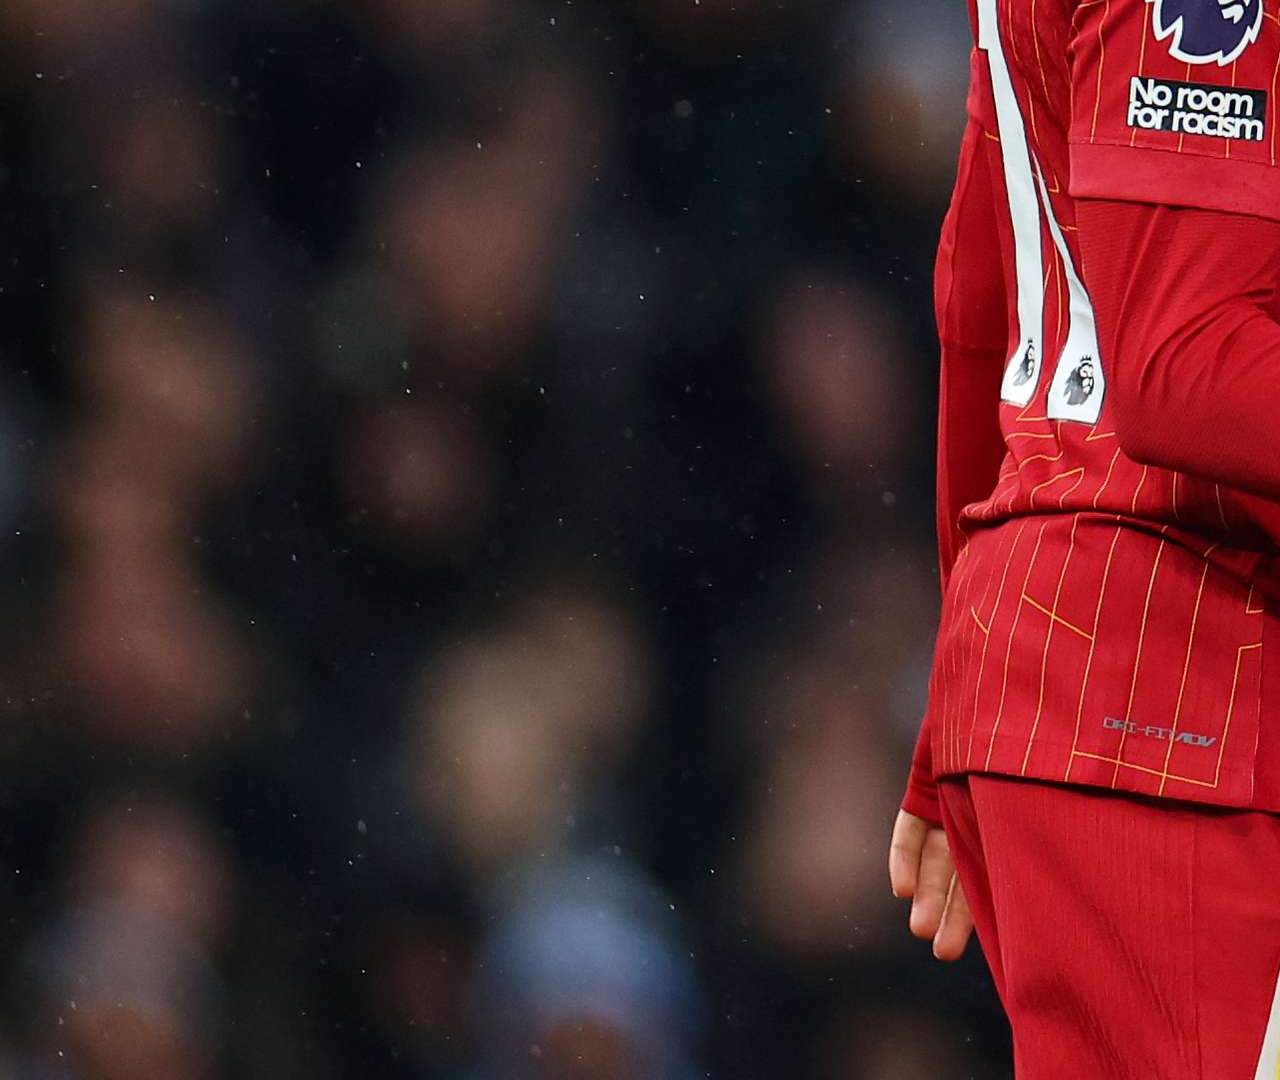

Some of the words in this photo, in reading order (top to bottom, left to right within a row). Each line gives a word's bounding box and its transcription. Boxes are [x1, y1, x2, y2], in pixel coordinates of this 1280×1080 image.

[1128, 76, 1173, 107] No
[1176, 86, 1254, 116] room
[1127, 100, 1169, 130] for
[1171, 109, 1264, 142] racism
